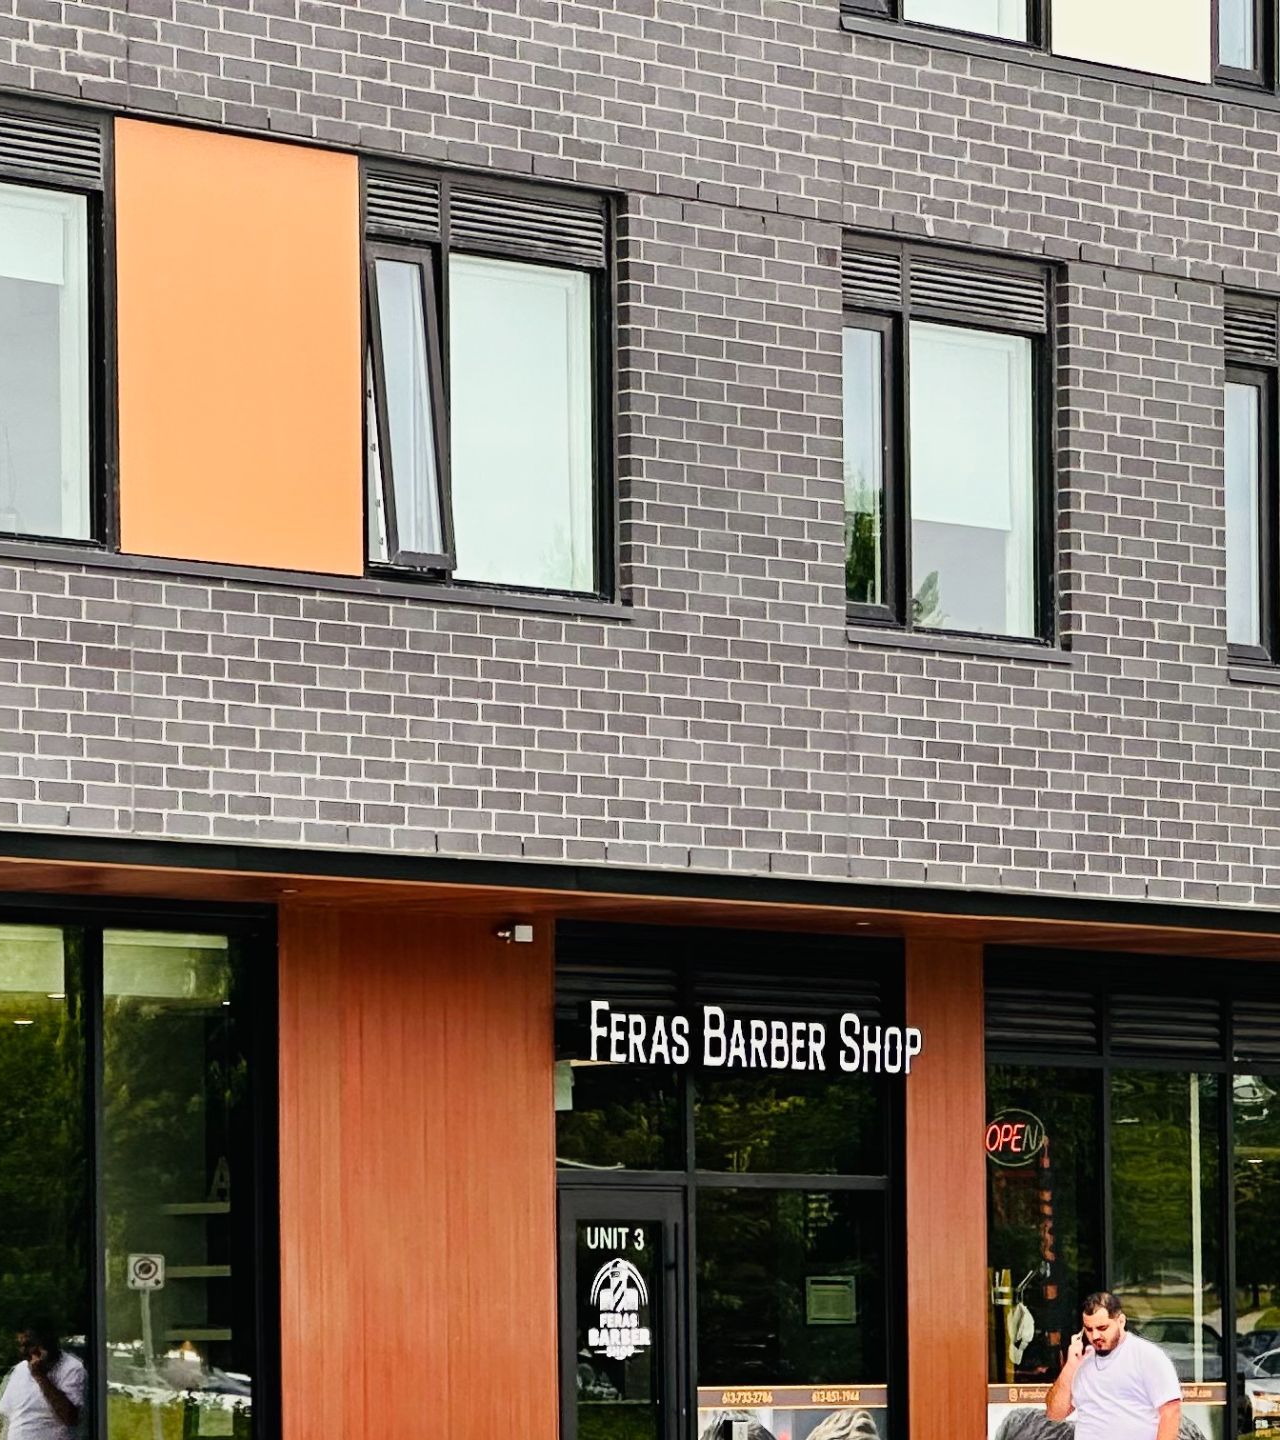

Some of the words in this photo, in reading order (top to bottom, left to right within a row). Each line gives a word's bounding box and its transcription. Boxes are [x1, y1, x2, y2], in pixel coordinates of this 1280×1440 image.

[590, 1000, 689, 1065] FERAS
[703, 1005, 826, 1071] BARBER
[839, 1012, 922, 1074] SHOP
[986, 1124, 1038, 1152] OPEN
[586, 1226, 629, 1250] UNIT
[634, 1228, 645, 1251] 3
